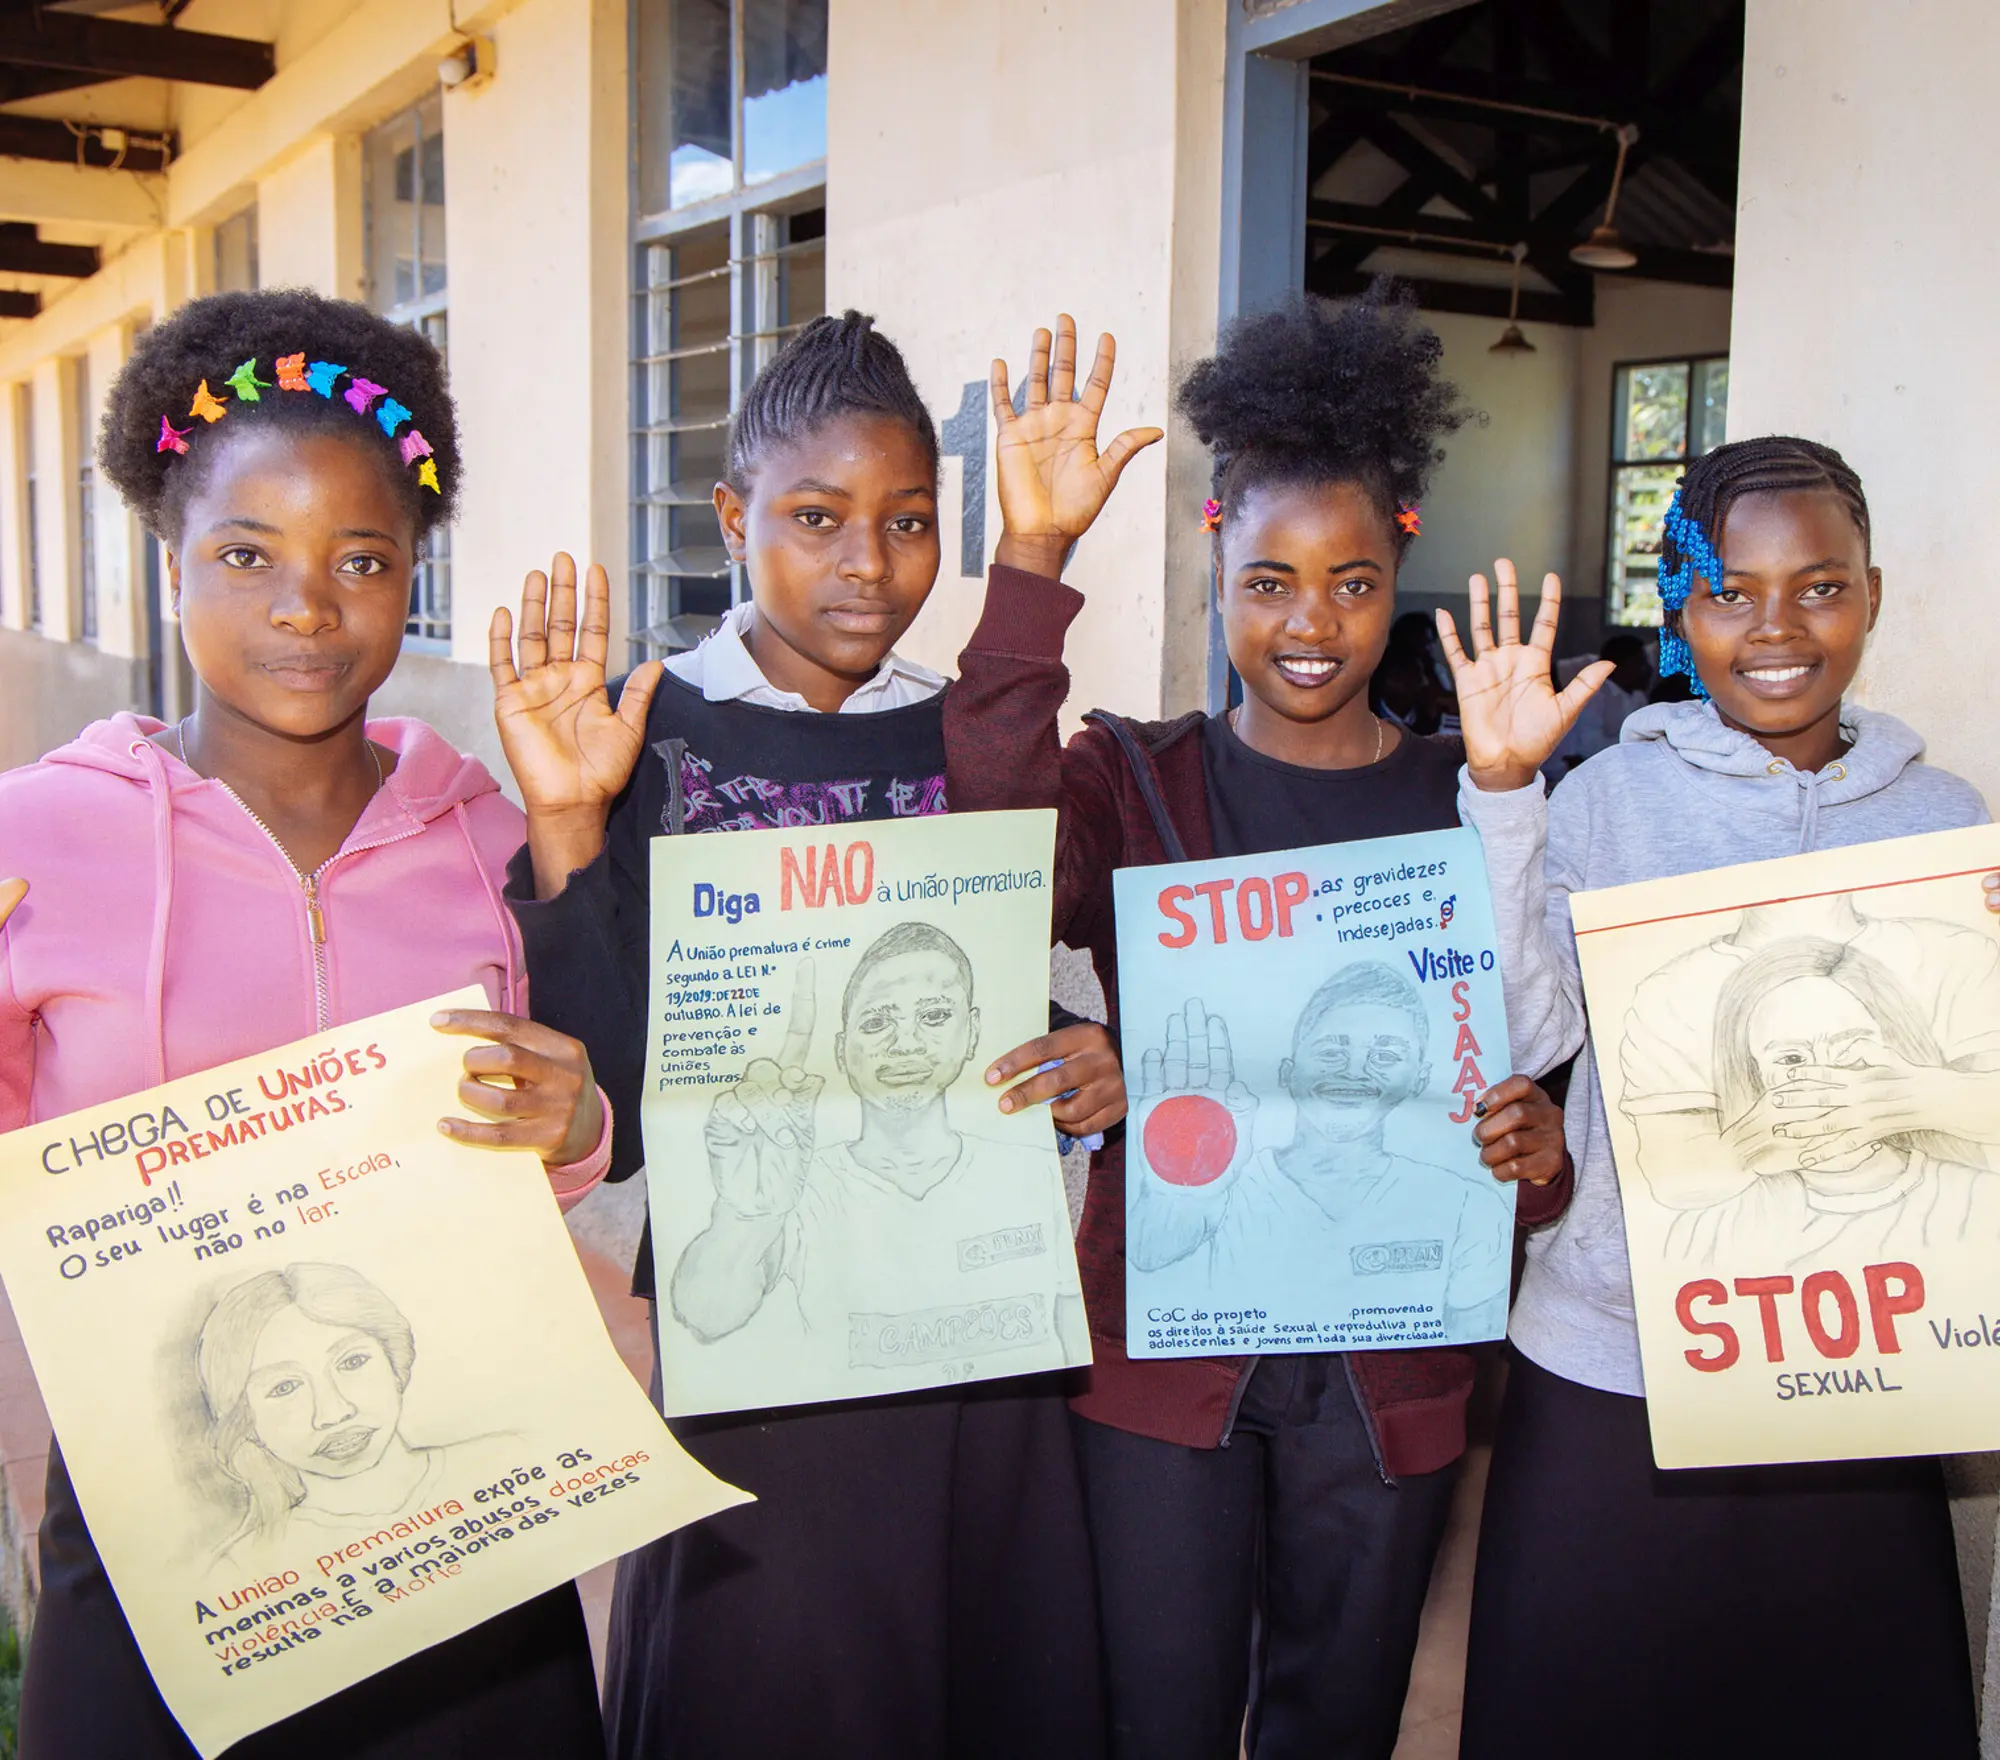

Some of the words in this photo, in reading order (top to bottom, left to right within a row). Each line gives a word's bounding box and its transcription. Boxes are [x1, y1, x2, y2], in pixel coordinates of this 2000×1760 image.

[693, 882, 760, 924] Diga
[877, 881, 892, 902] à
[953, 869, 1046, 906] prematura.
[1157, 871, 1309, 949] STOP
[1353, 861, 1447, 896] gravidezes
[1332, 892, 1411, 924] precoces
[666, 939, 683, 962] A
[729, 940, 798, 961] prematura
[802, 937, 811, 951] é
[1408, 947, 1475, 983] Visite
[666, 969, 719, 988] segundo
[723, 968, 733, 980] a
[737, 964, 756, 979] LEI
[727, 1003, 736, 1017] A
[739, 1003, 757, 1018] lei
[763, 1002, 781, 1015] de
[748, 1026, 757, 1036] e
[662, 1042, 727, 1058] combate
[730, 1041, 745, 1055] às
[659, 1071, 743, 1091] prematuras
[205, 1088, 250, 1121] DE
[46, 1180, 184, 1248] Rapariga!!
[60, 1254, 87, 1279] O
[95, 1240, 142, 1267] seu
[157, 1209, 228, 1243] lugar
[247, 1193, 264, 1215] é
[275, 1183, 309, 1205] na
[317, 1153, 400, 1190] Escola,
[194, 1232, 243, 1260] não
[253, 1220, 286, 1240] no
[1148, 1329, 1162, 1338] os
[1166, 1326, 1212, 1337] direitos
[1229, 1324, 1265, 1334] saúde
[1323, 1324, 1330, 1332] e
[1334, 1320, 1406, 1333] reprodutiva
[1413, 1319, 1442, 1329] para
[1191, 1309, 1208, 1321] do
[1214, 1308, 1267, 1325] projeto
[1351, 1304, 1433, 1320] promovendo
[1675, 1261, 1925, 1372] STOP
[1149, 1336, 1235, 1349] adolescentes
[1243, 1337, 1250, 1345] e
[1296, 1335, 1313, 1343] em
[1317, 1333, 1346, 1343] toda
[1352, 1333, 1372, 1343] sua
[1776, 1368, 1902, 1401] SEXUAL
[194, 1600, 218, 1624] A
[473, 1466, 546, 1503] expõe
[556, 1448, 592, 1469] as
[374, 1577, 396, 1594] a
[409, 1527, 514, 1577] maioria
[518, 1507, 560, 1530] das
[567, 1471, 640, 1508] vezes
[205, 1586, 327, 1645] meninas
[336, 1573, 356, 1588] a
[362, 1535, 447, 1576] varios
[449, 1495, 541, 1541] abusos
[221, 1627, 322, 1676] resulta
[331, 1604, 373, 1626] na
